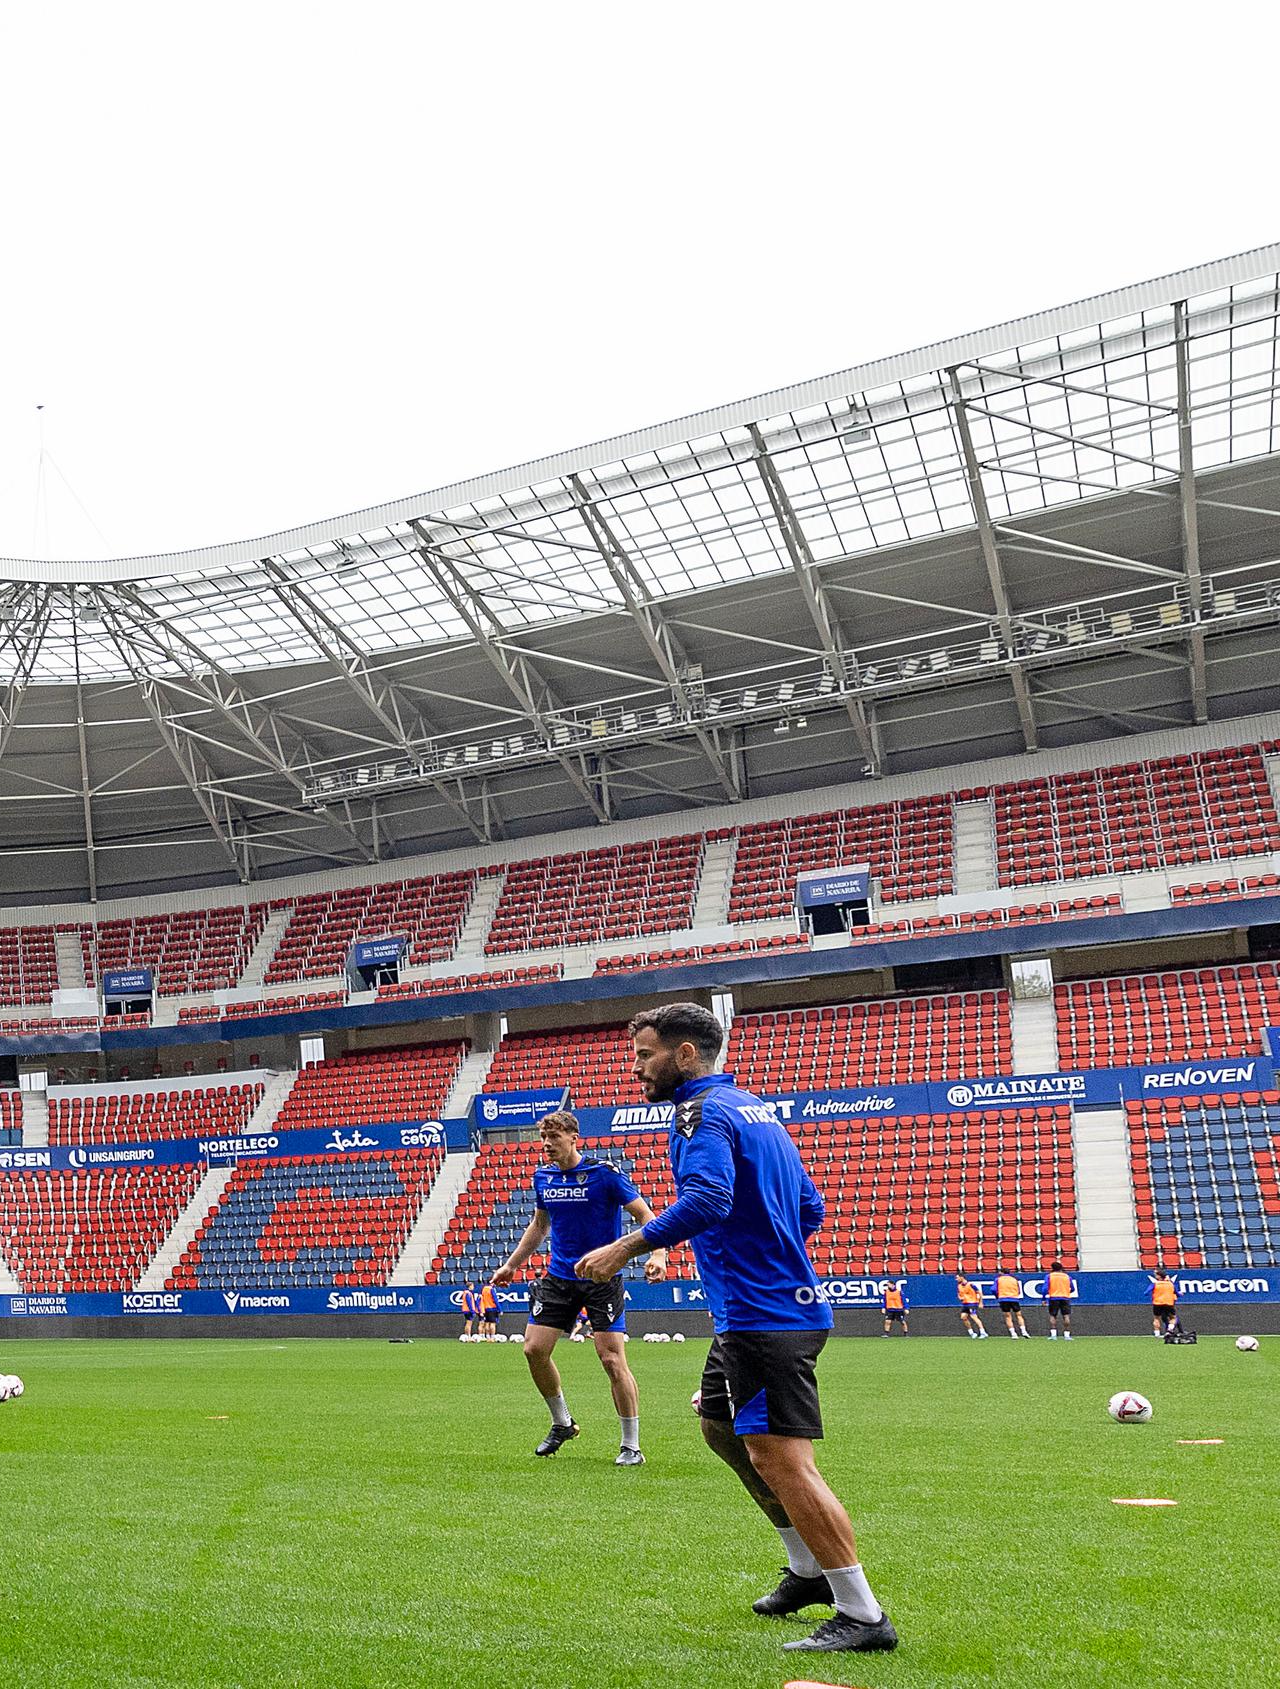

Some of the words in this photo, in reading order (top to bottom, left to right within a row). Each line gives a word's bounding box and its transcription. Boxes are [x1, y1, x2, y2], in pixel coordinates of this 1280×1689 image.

[1143, 1063, 1256, 1089] RENOVEN
[971, 1076, 1086, 1098] MAINATE
[802, 1094, 896, 1118] Automotive
[400, 1128, 419, 1137] grupo
[401, 1132, 441, 1148] cetya
[198, 1136, 279, 1153] NORTELECO
[1178, 1277, 1269, 1294] macron
[28, 1297, 55, 1305] DIARIO
[240, 1295, 290, 1308] macron
[327, 1291, 397, 1310] SanMiguel
[28, 1306, 68, 1314] NAVARRA
